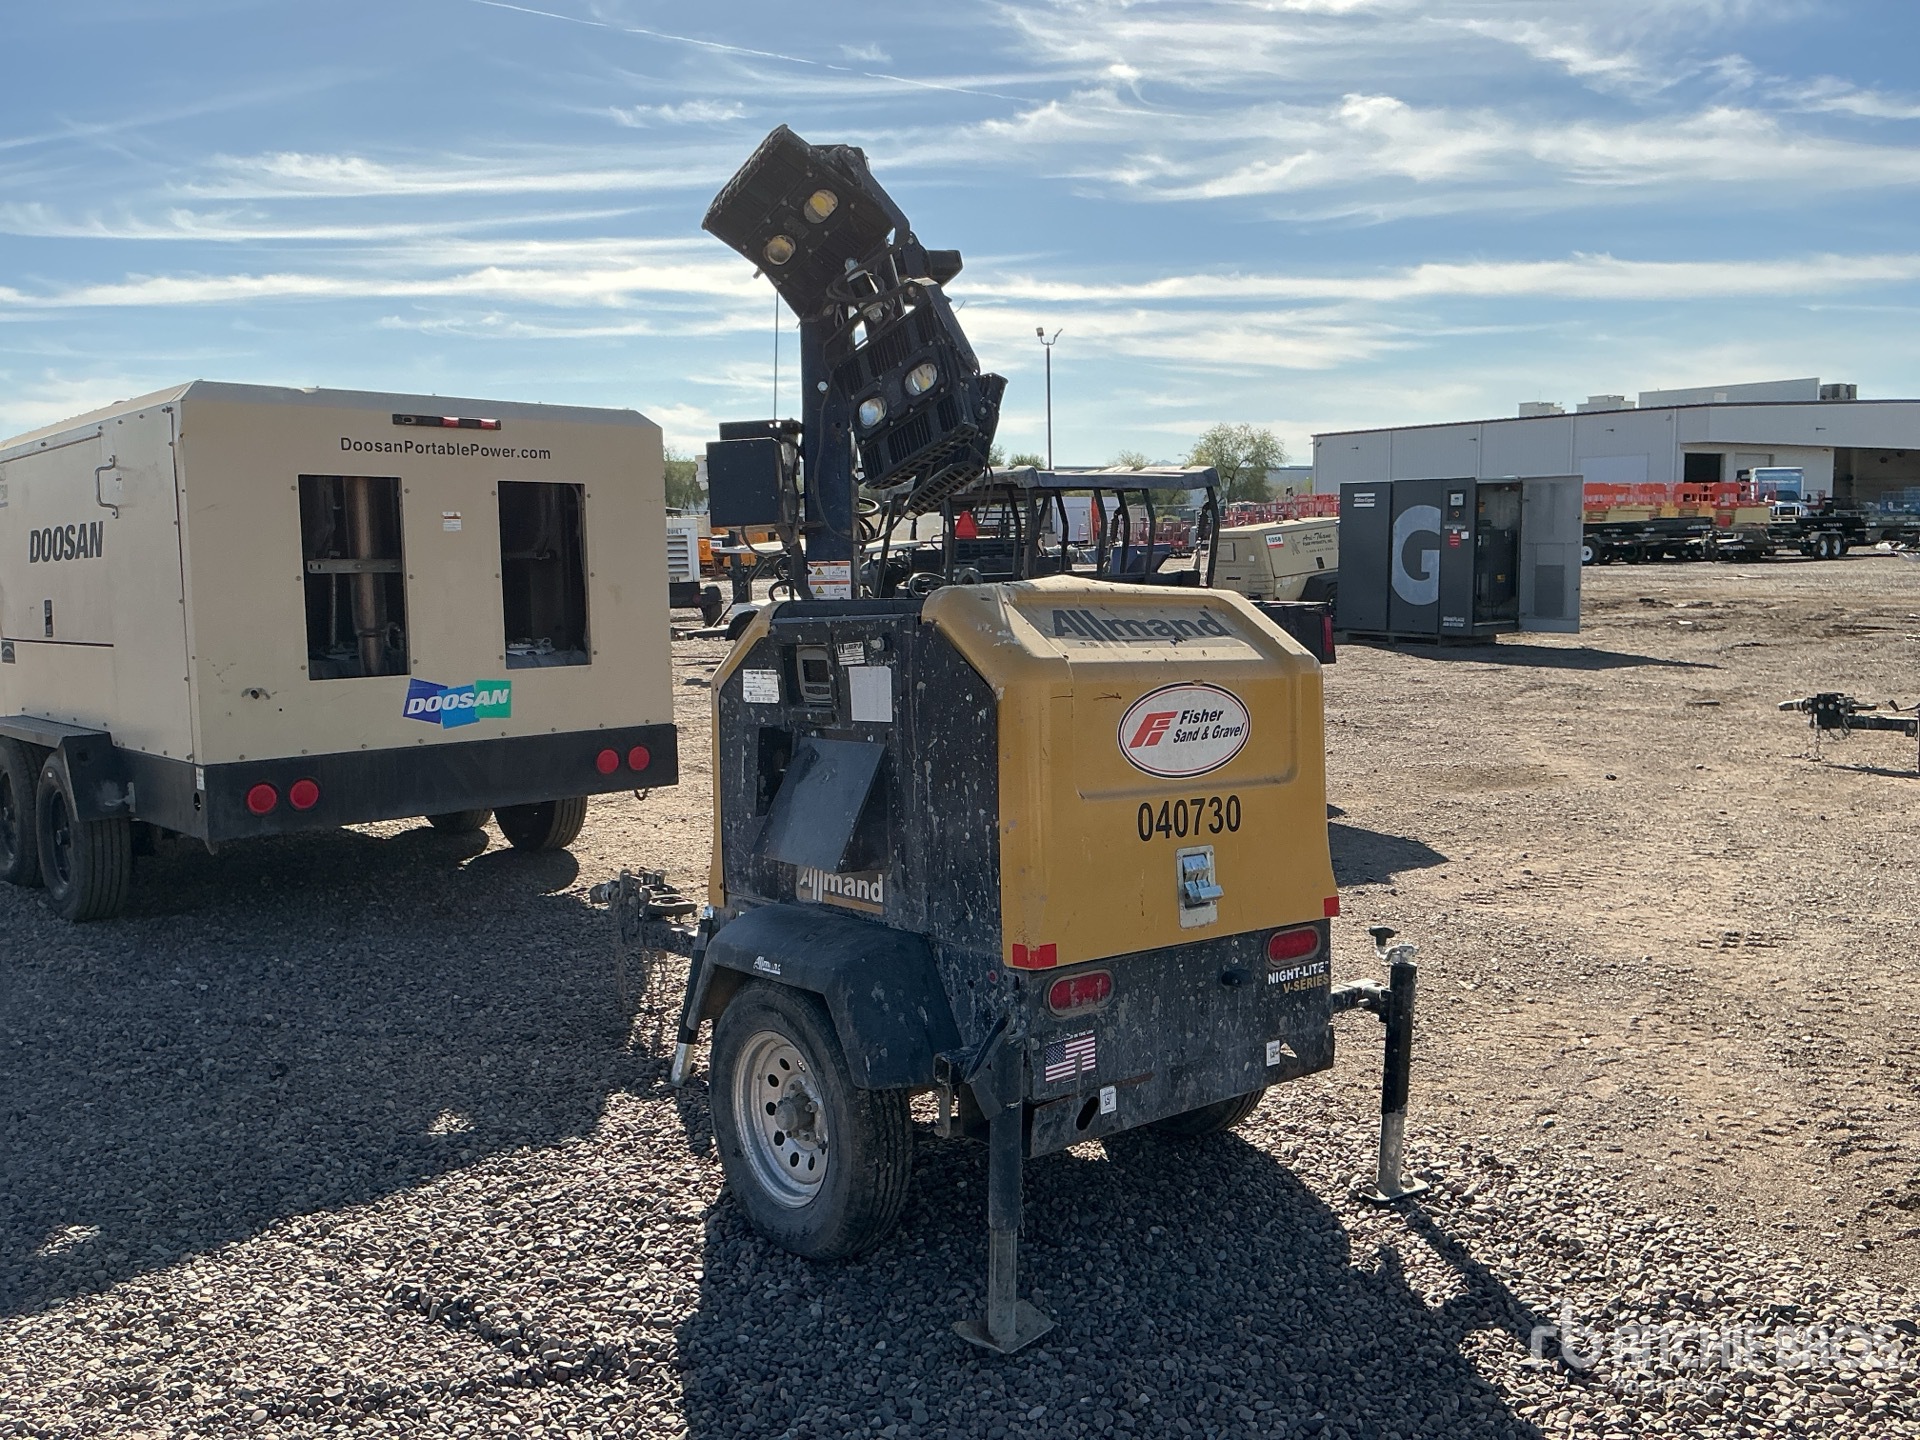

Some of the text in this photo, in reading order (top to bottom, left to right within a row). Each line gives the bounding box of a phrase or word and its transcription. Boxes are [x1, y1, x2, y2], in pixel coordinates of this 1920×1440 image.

[340, 437, 552, 460] DoosanPortablePower.com
[29, 520, 104, 564] DOOSAN
[1052, 608, 1233, 645] Allmand
[407, 688, 509, 715] DOOSAN
[1179, 709, 1224, 726] Fisher
[1173, 722, 1246, 744] Sand & Gravel
[1137, 794, 1242, 842] 040730
[799, 866, 884, 904] Allmand
[1282, 973, 1330, 994] V-SERIES
